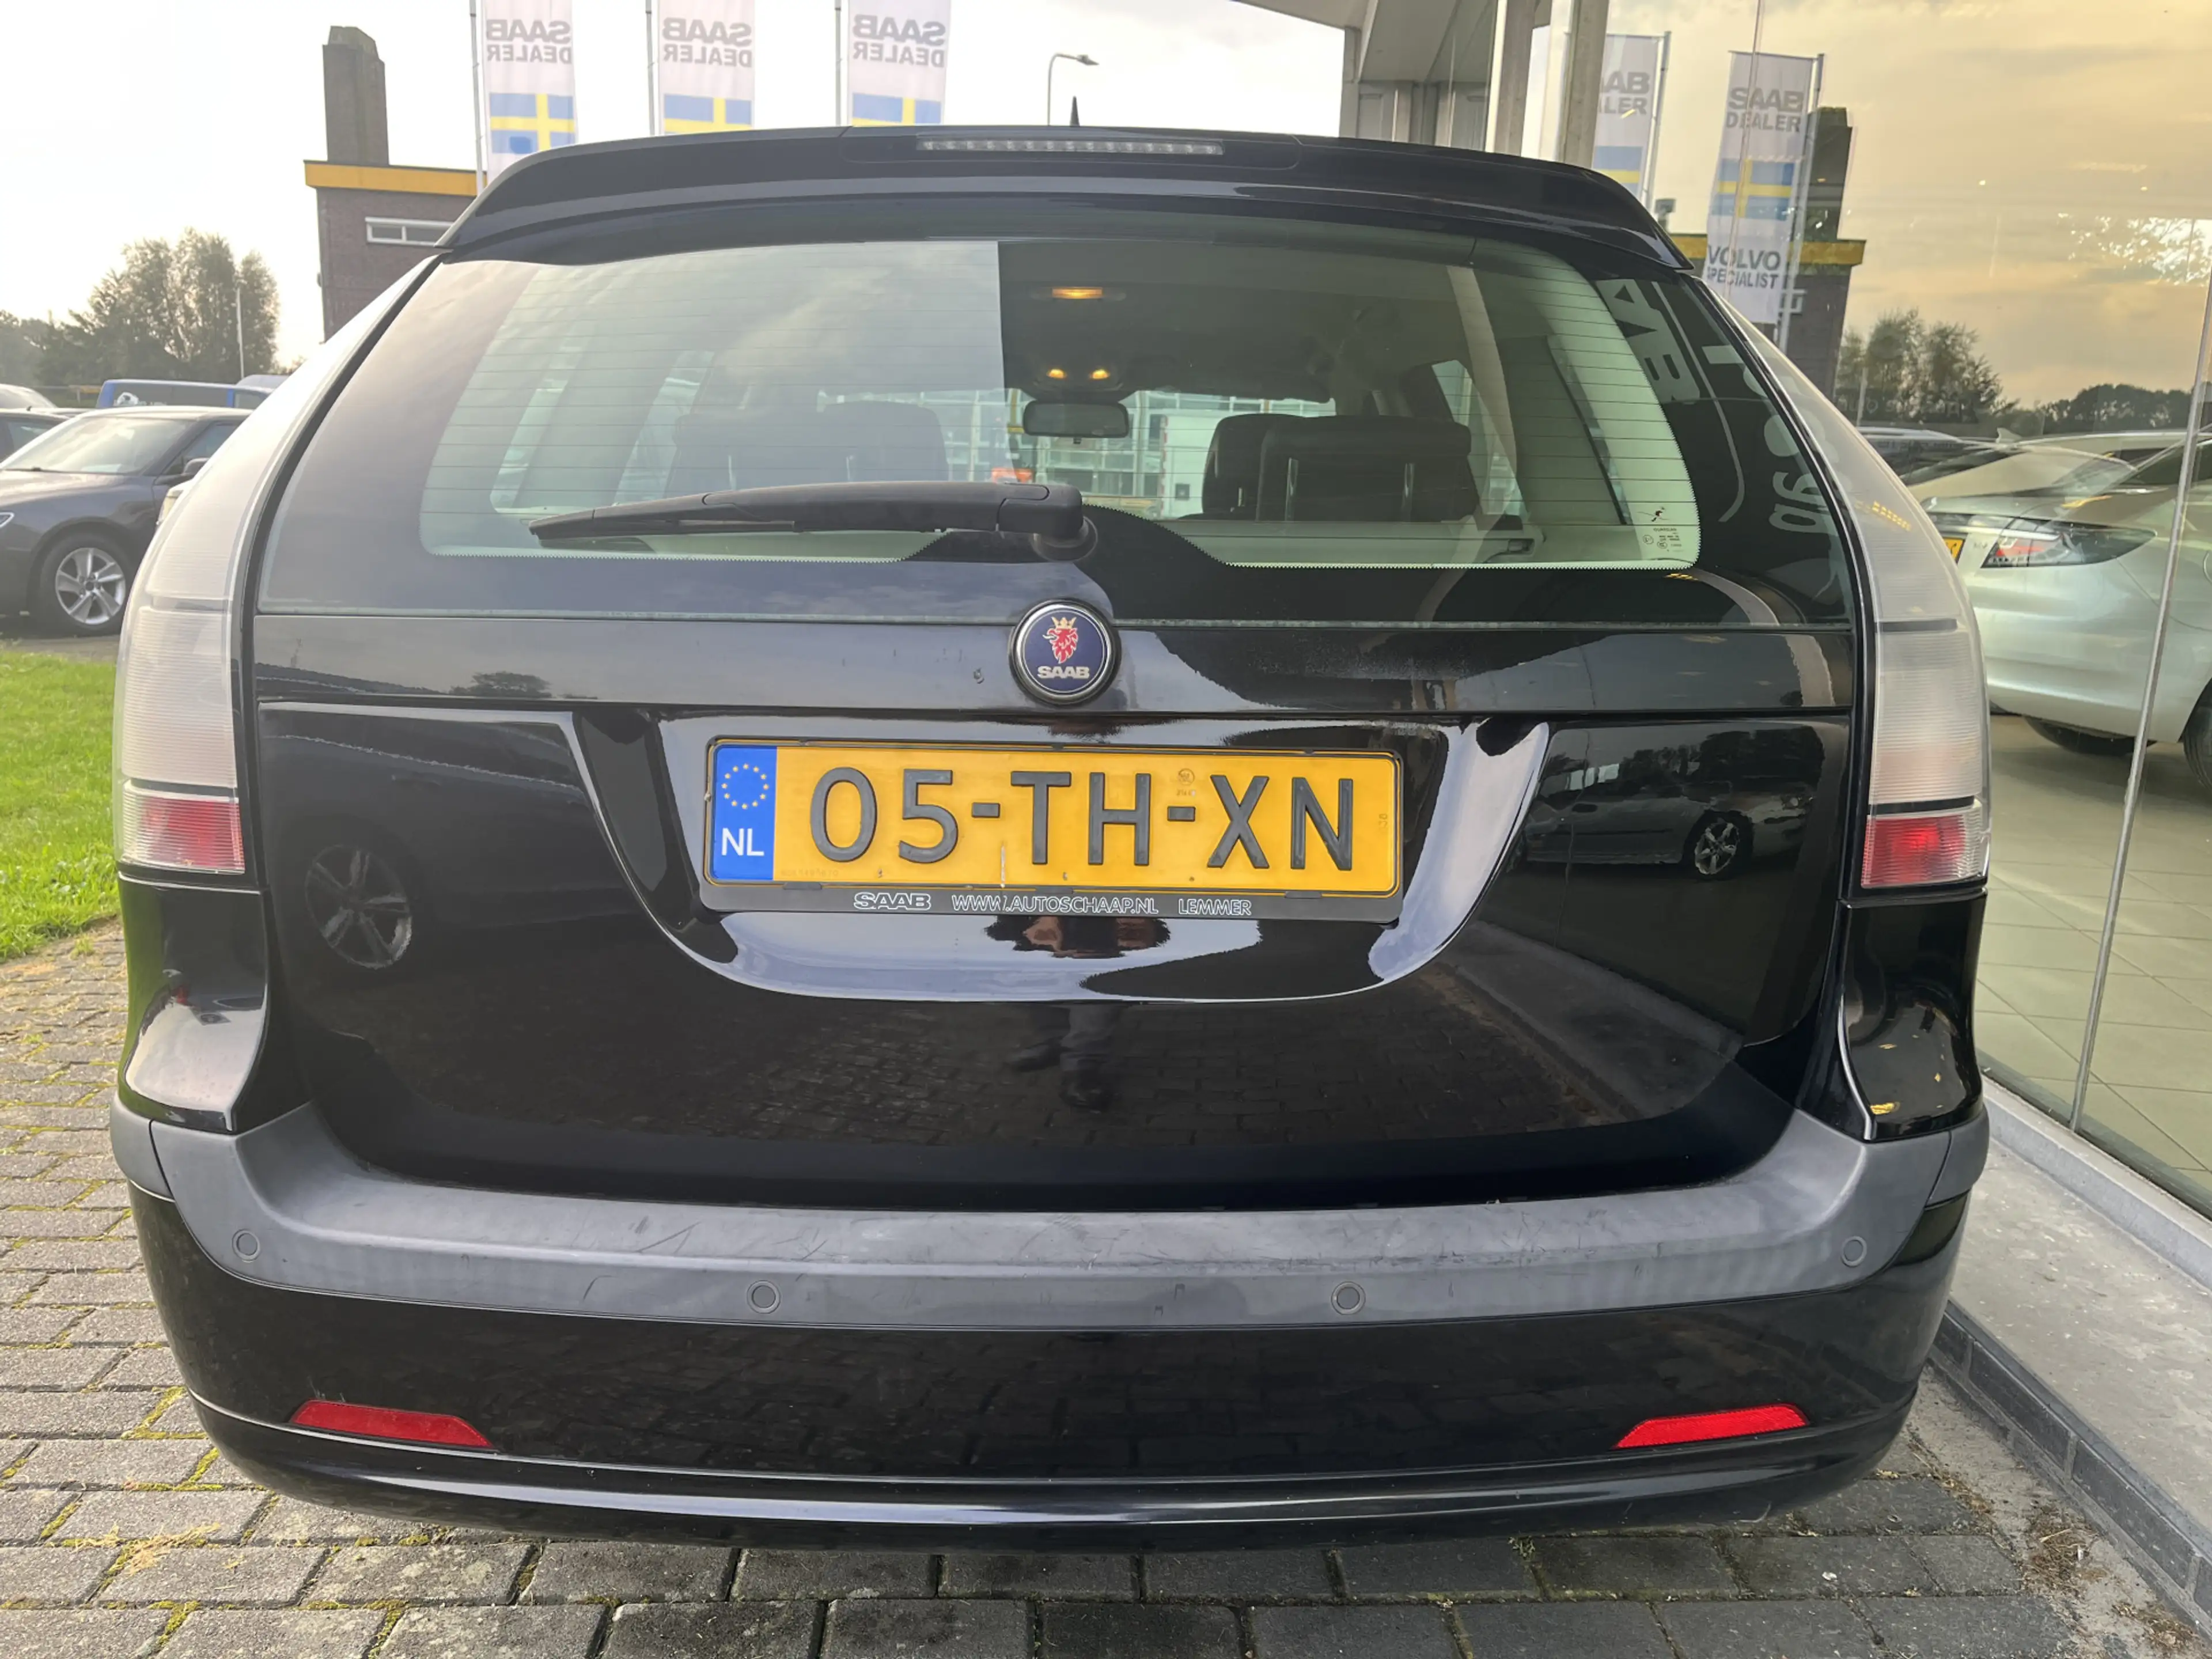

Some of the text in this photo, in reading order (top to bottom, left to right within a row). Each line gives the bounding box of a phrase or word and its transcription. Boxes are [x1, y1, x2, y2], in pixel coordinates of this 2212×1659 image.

[1601, 71, 1650, 94] AB
[1600, 96, 1648, 116] LER
[1728, 87, 1805, 113] SAAB
[1726, 112, 1802, 132] DEALER
[1709, 245, 1781, 271] VOLVO
[1037, 666, 1090, 679] SAAB
[809, 766, 1354, 871] 05-TH-XN
[721, 827, 765, 857] NL
[853, 892, 1252, 916] SAAB WWW.AUTOSCHAAP.NL LEMMER
